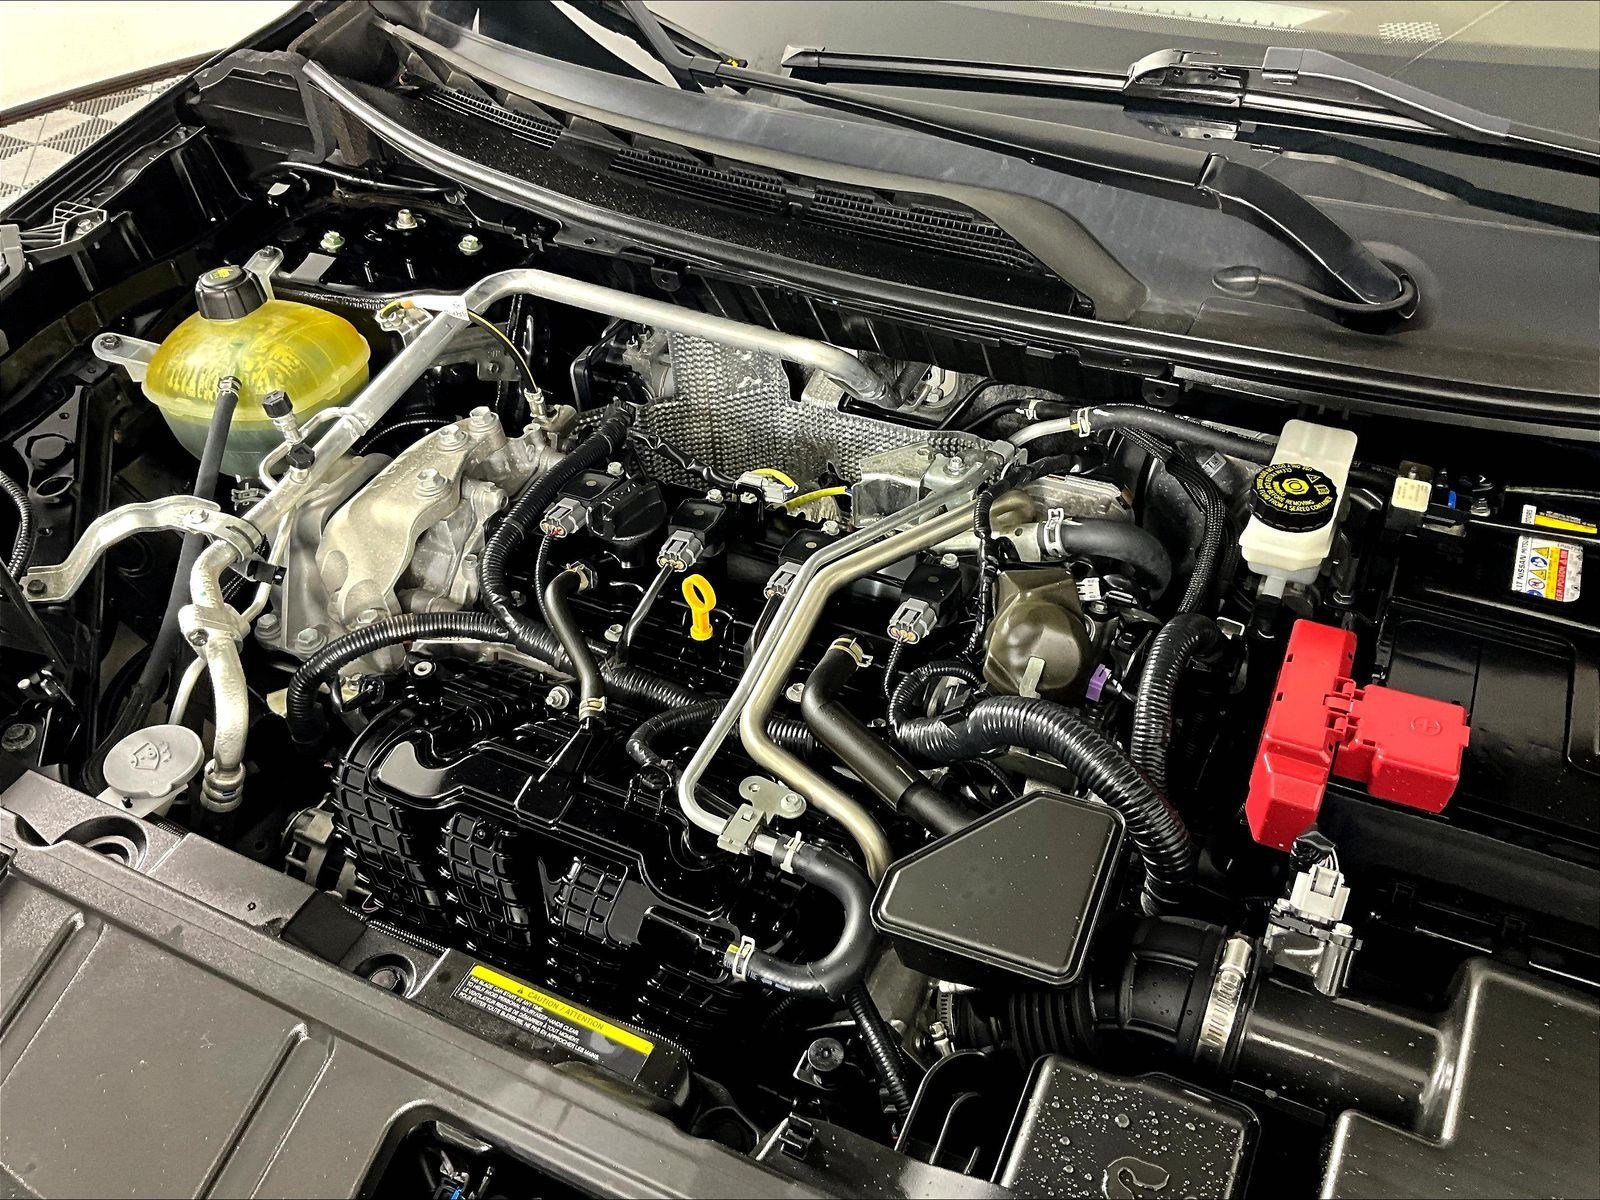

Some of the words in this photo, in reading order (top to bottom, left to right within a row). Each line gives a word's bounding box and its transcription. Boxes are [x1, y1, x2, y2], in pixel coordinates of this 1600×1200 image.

[1517, 555, 1527, 580] NISSAN
[473, 984, 486, 992] HELP
[484, 989, 498, 998] AVOID
[479, 980, 494, 989] BLADE
[503, 991, 517, 1000] START
[526, 992, 559, 1009] CAUTION
[564, 1009, 604, 1030] ATTENTION
[546, 1025, 559, 1034] TOUT
